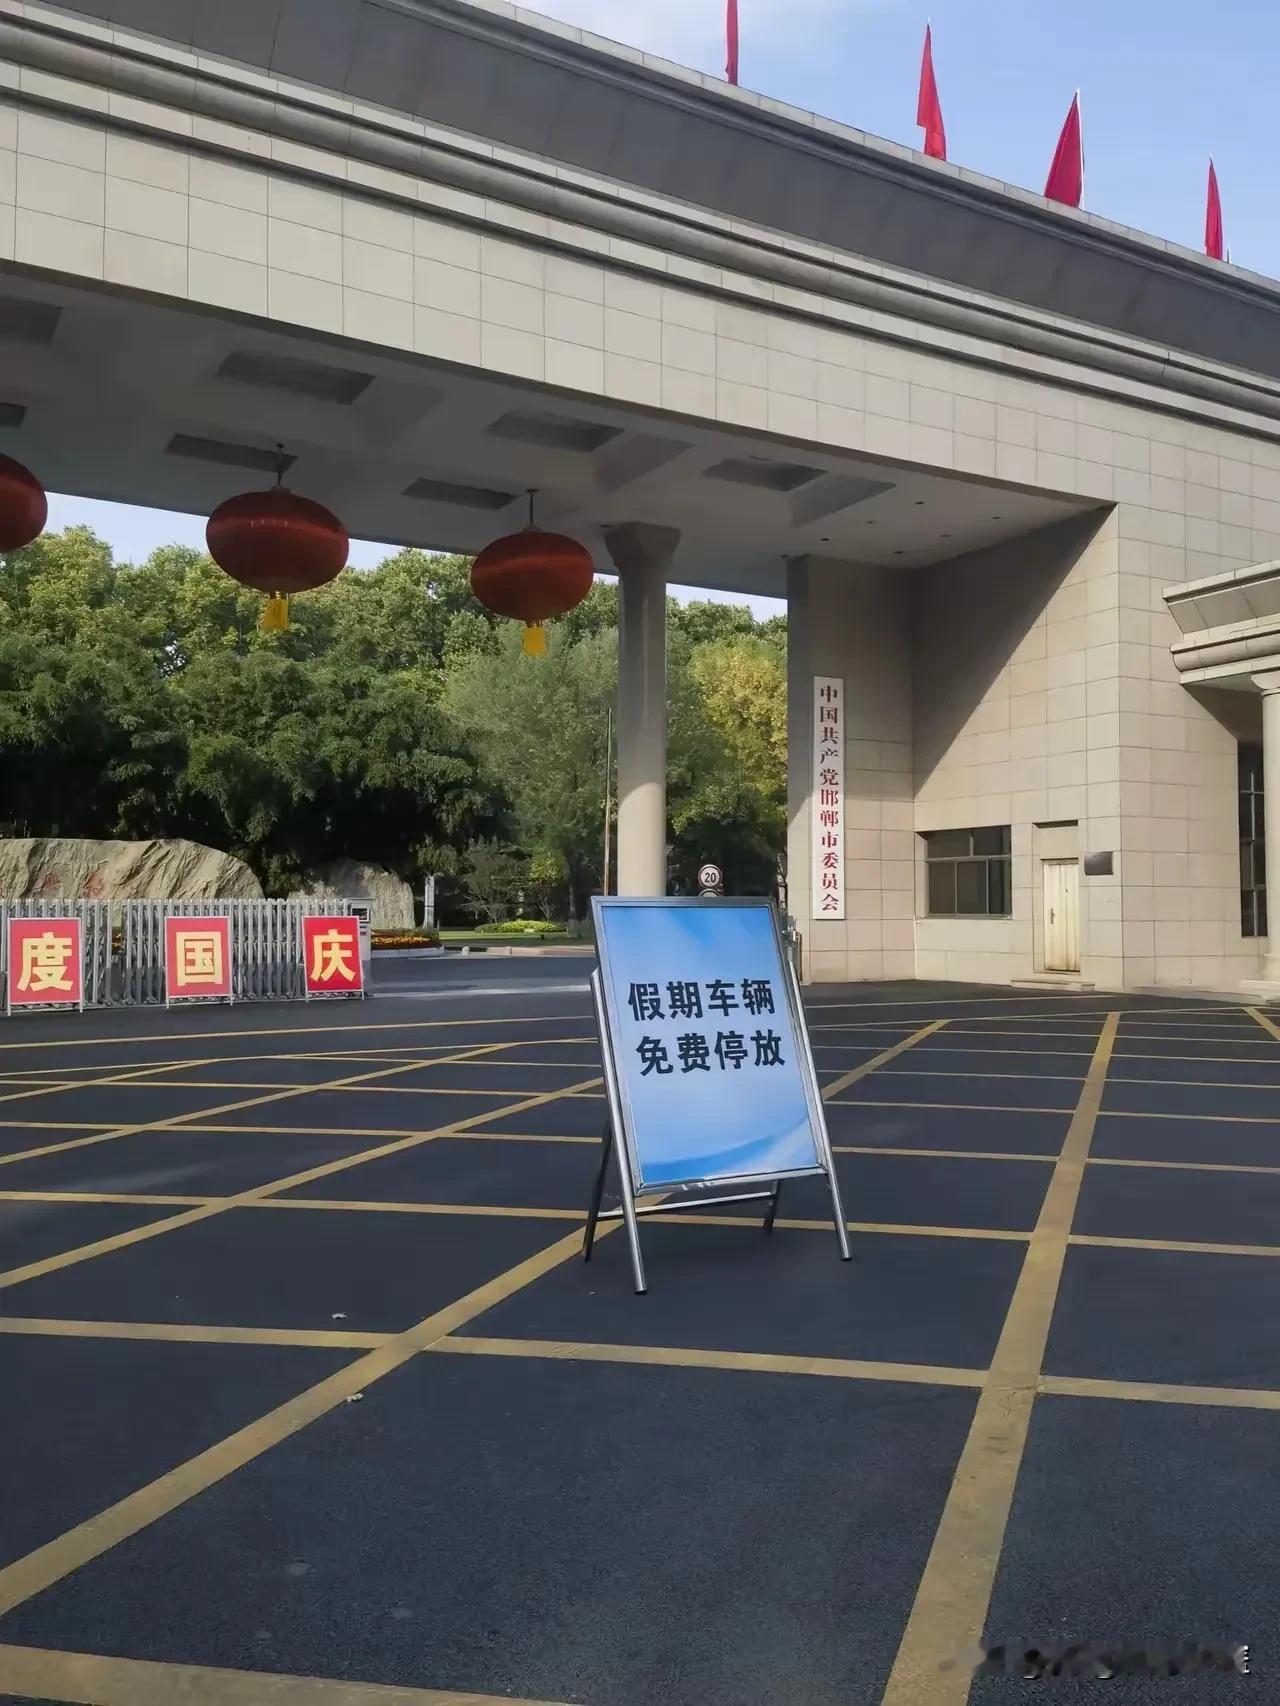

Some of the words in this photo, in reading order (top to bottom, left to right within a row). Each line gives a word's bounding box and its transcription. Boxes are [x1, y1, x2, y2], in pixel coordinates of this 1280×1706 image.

[820, 685, 839, 911] 中国共产党邯郸市委员会
[704, 872, 717, 883] 20
[16, 931, 73, 992] 度
[176, 931, 223, 986] 国
[310, 928, 356, 982] 庆
[627, 978, 776, 1022] 假期车辆
[635, 1029, 785, 1076] 免费停放
